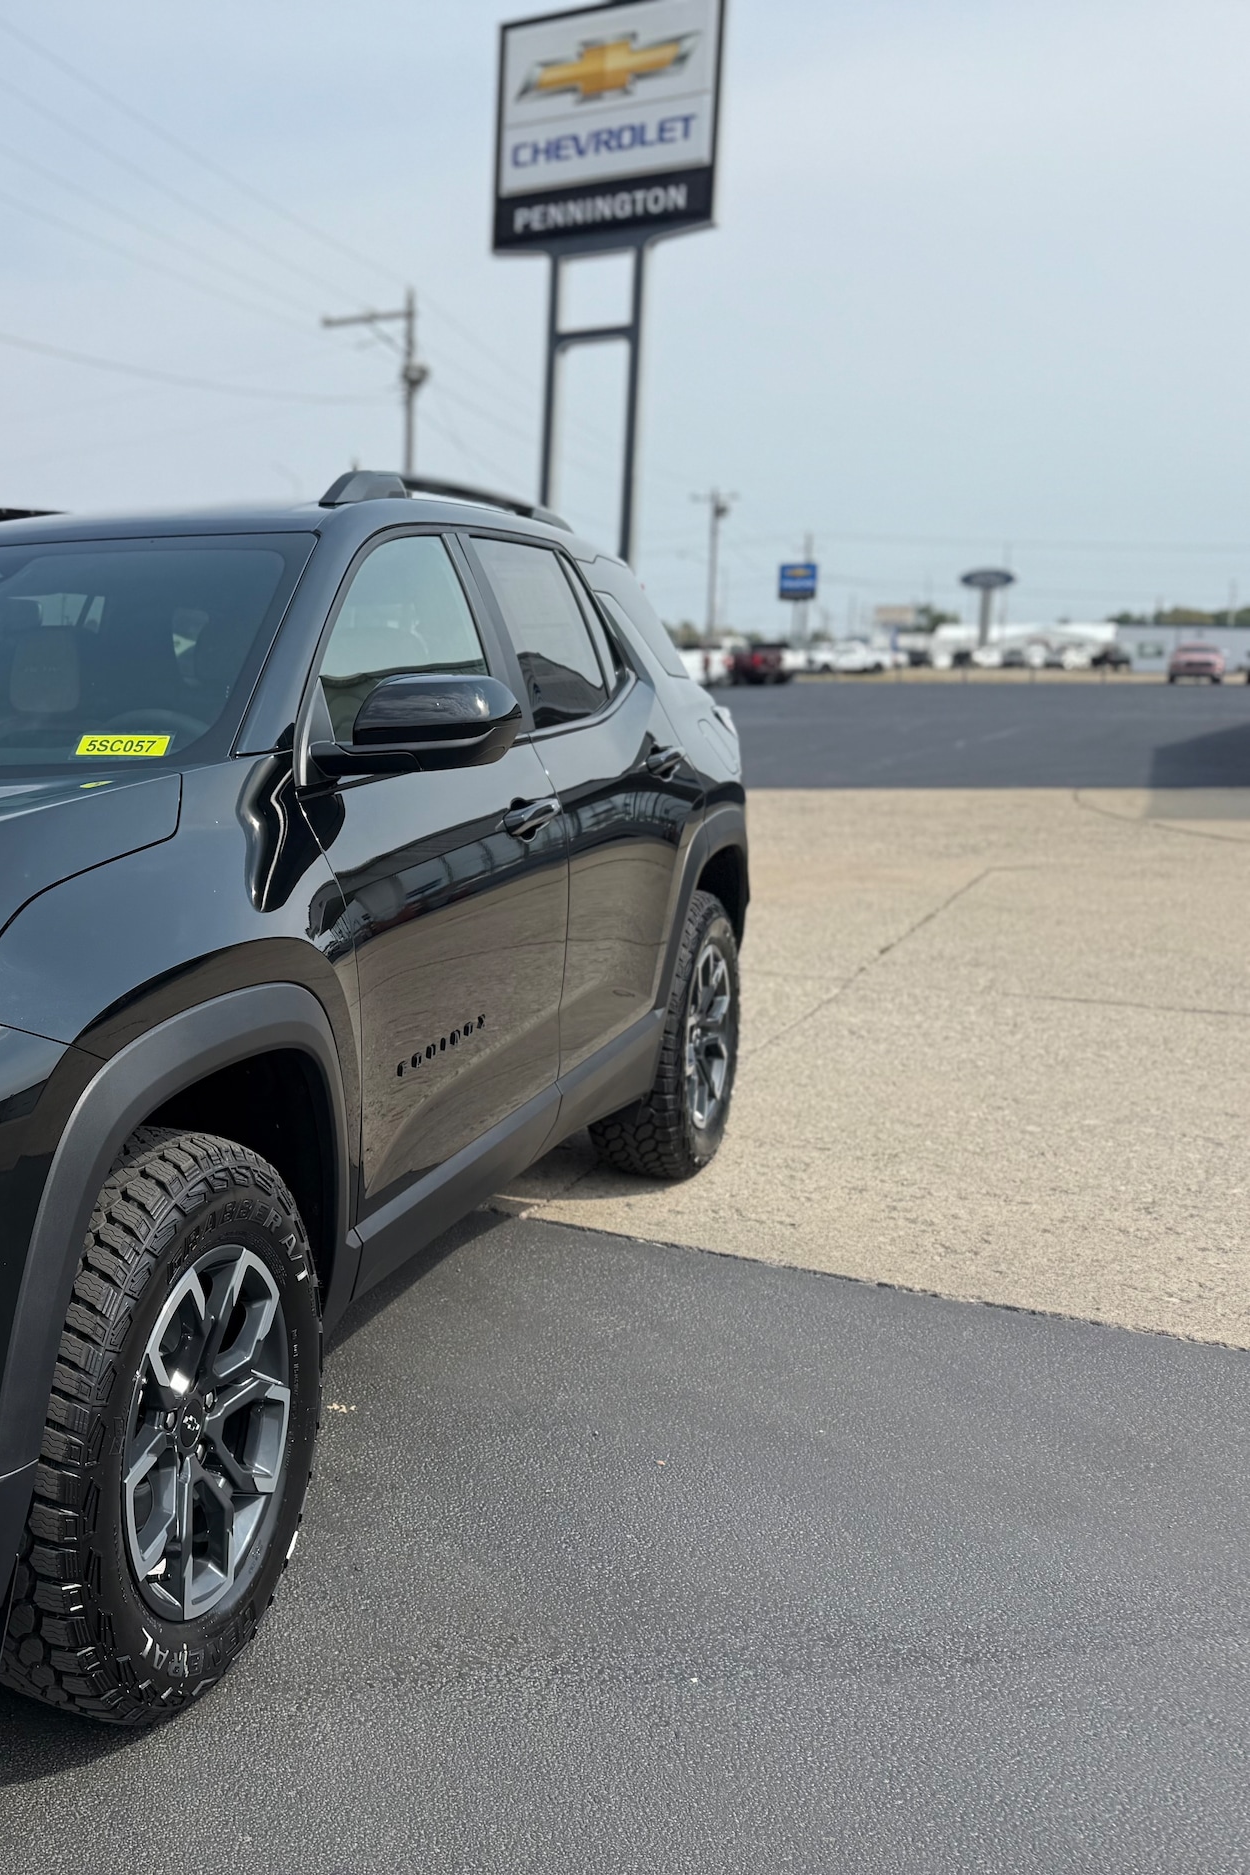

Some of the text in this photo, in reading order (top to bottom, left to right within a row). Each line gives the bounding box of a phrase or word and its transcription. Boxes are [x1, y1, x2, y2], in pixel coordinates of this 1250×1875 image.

[511, 113, 697, 169] CHEVROLET
[513, 184, 688, 234] PENNINGTON
[86, 740, 157, 753] 5SC057
[397, 1013, 486, 1077] EQUINOX
